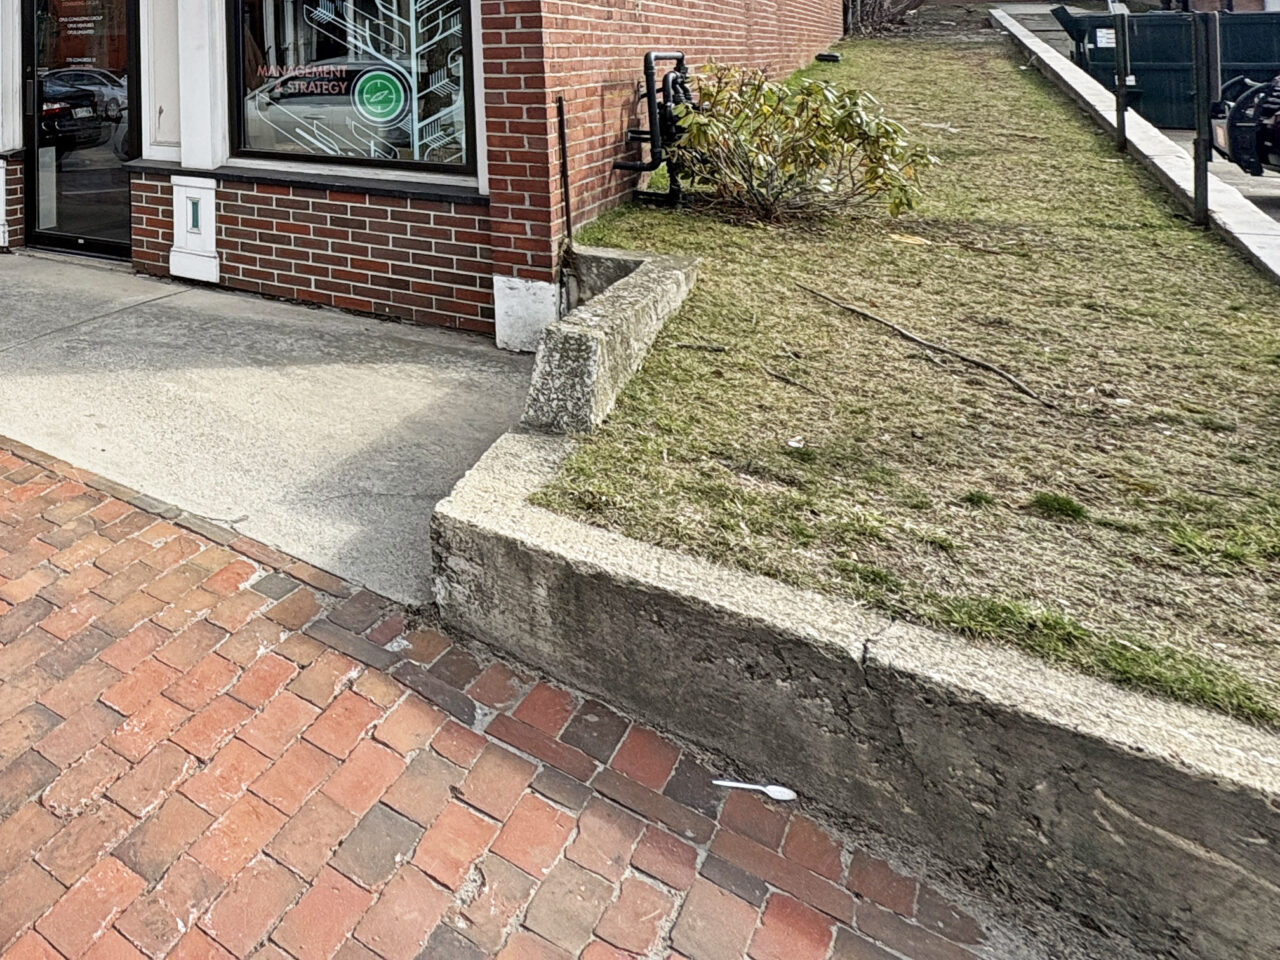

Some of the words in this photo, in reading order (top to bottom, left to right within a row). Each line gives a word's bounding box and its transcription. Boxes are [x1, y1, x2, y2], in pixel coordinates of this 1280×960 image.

[257, 64, 348, 78] MANAGEMENT
[275, 81, 284, 93] &
[287, 80, 348, 94] STRATEGY
